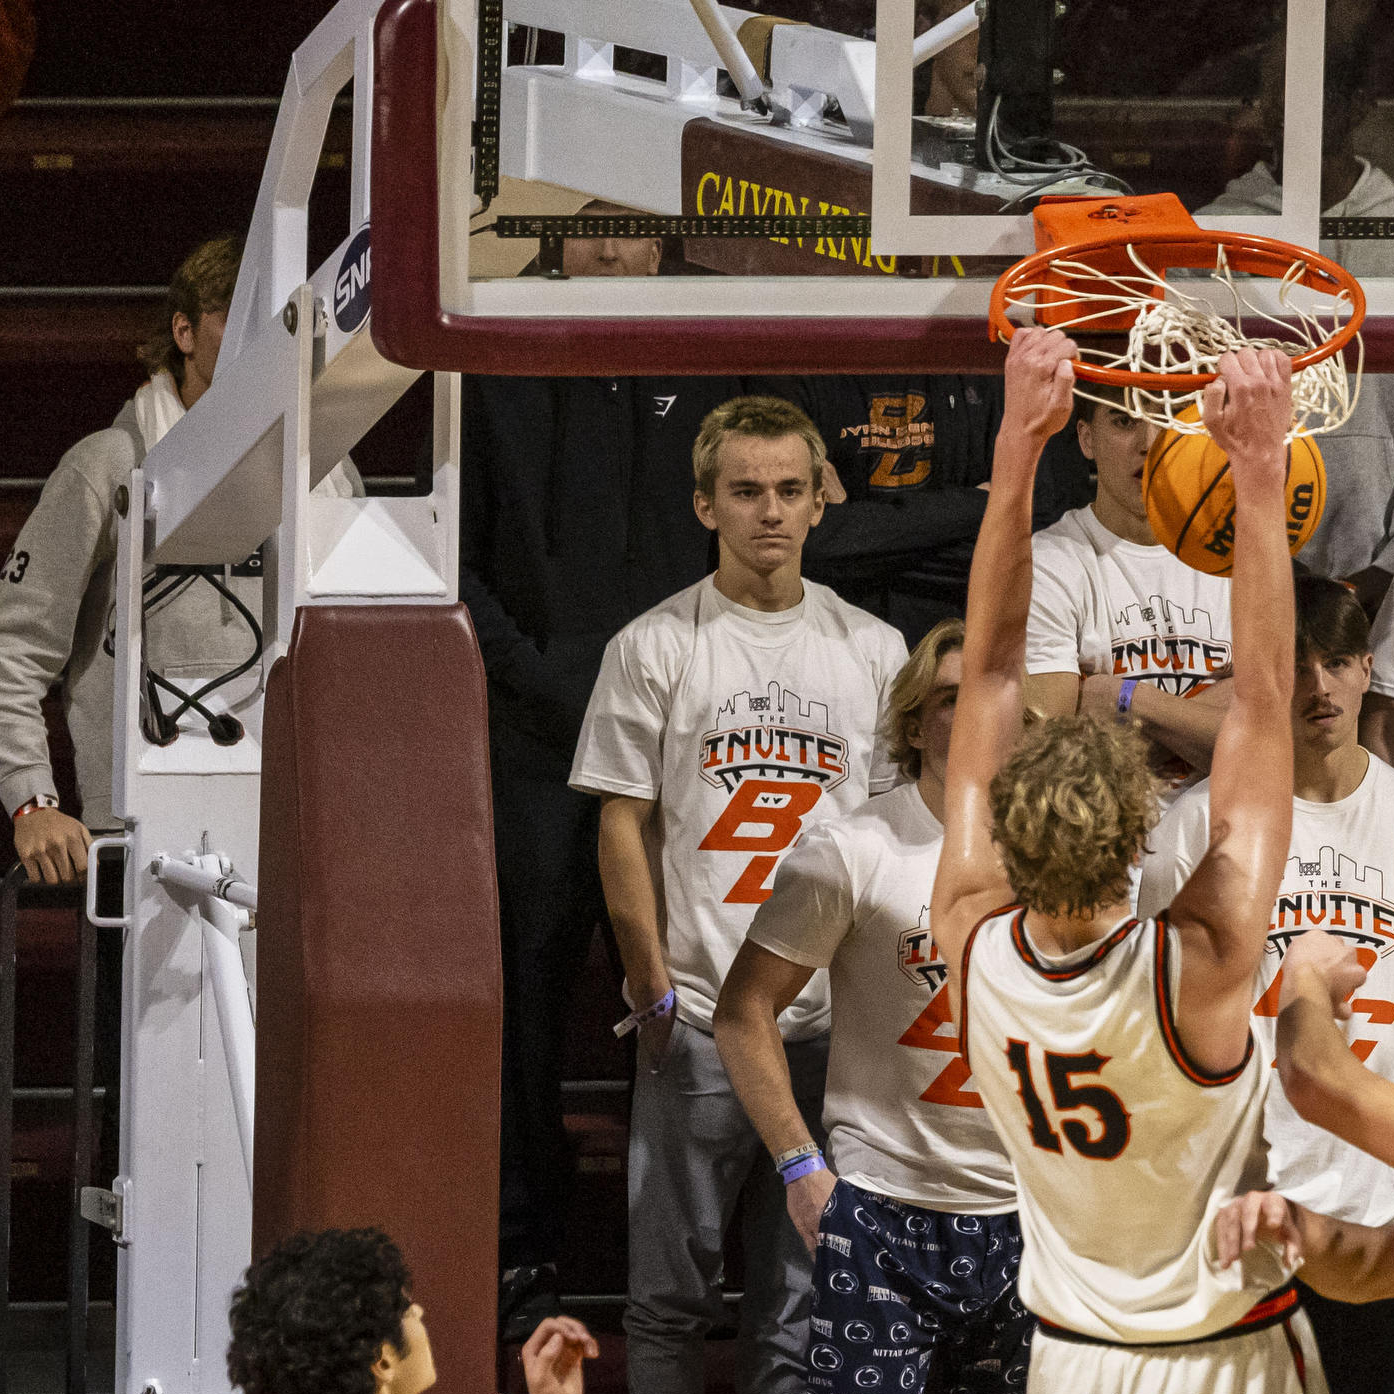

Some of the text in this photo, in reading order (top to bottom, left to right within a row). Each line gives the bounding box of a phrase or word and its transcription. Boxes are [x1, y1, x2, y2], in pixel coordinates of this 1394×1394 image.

[1152, 624, 1174, 634] TE
[1112, 638, 1227, 676] INVITE
[759, 715, 785, 724] THE
[703, 729, 843, 774] INVITE
[1309, 880, 1341, 888] THE
[1003, 1036, 1132, 1161] 15
